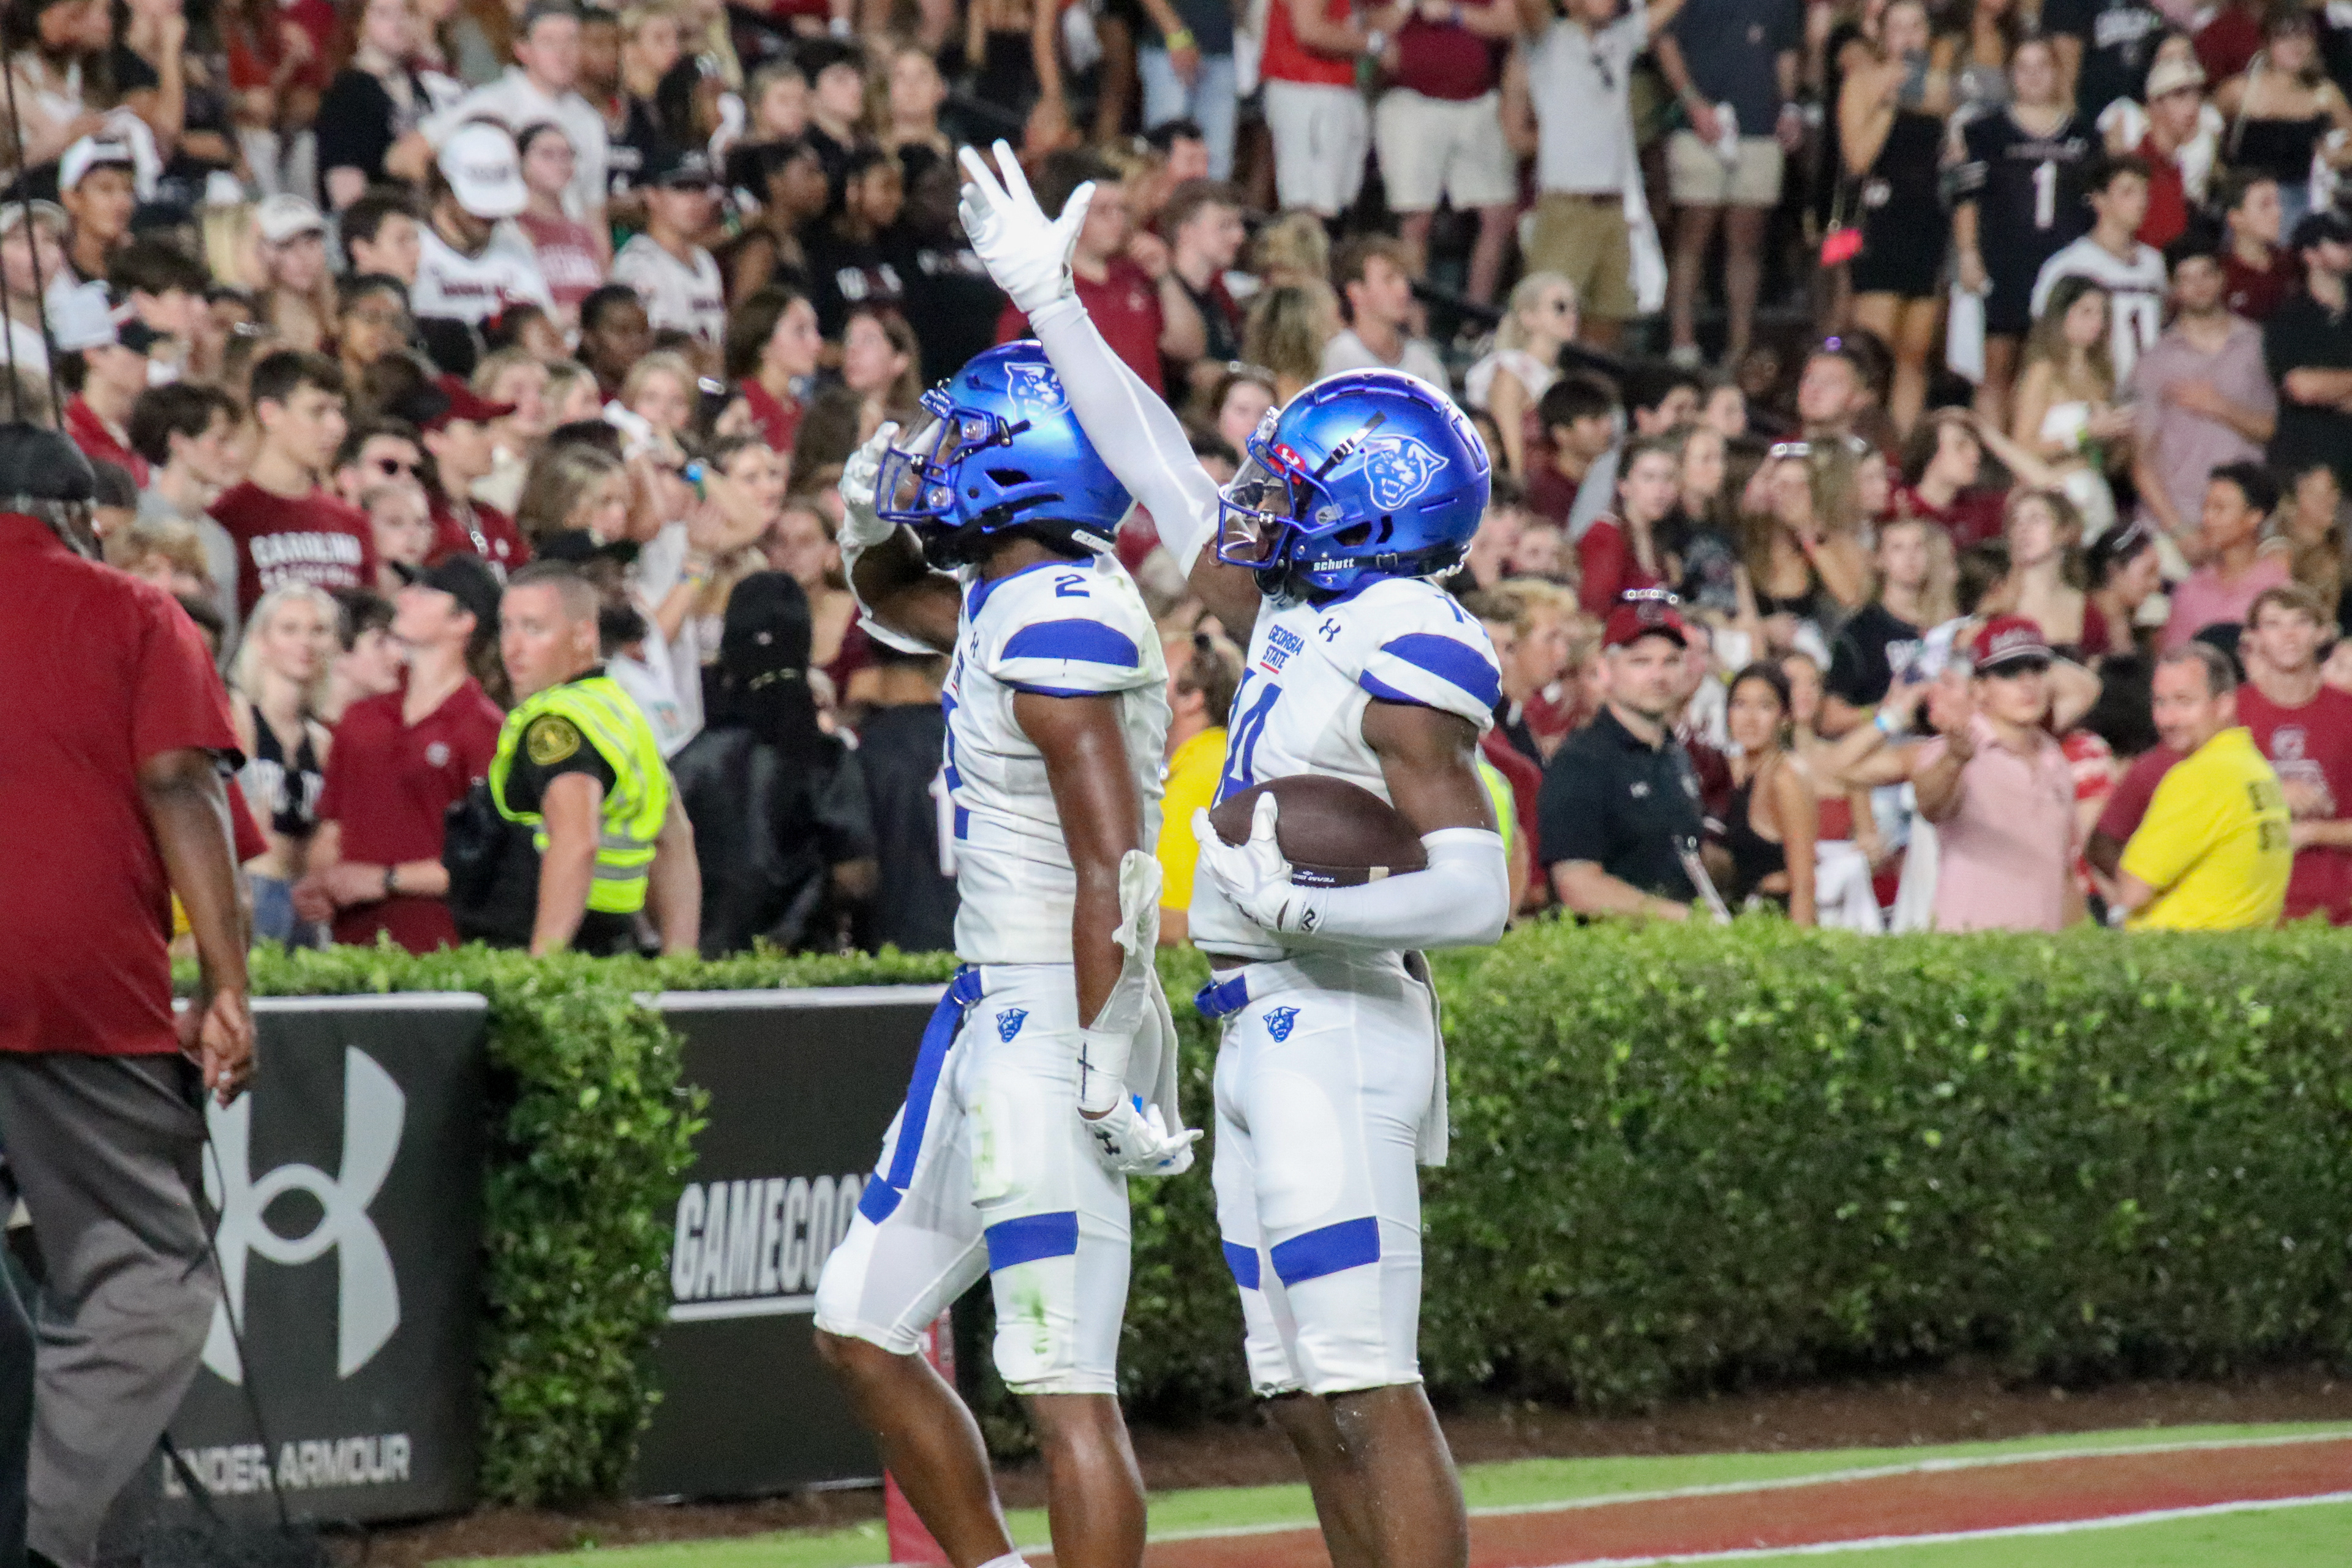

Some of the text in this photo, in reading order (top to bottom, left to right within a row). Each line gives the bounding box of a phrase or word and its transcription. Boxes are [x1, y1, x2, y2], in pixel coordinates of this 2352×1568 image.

[2032, 159, 2057, 228] 1
[1313, 557, 1354, 571] schutt
[1055, 574, 1090, 598] 2
[1268, 624, 1305, 656] GEORGIA
[1262, 644, 1290, 669] STATE
[671, 1173, 872, 1300] GAMECOC
[276, 1433, 410, 1490] ARMOUR
